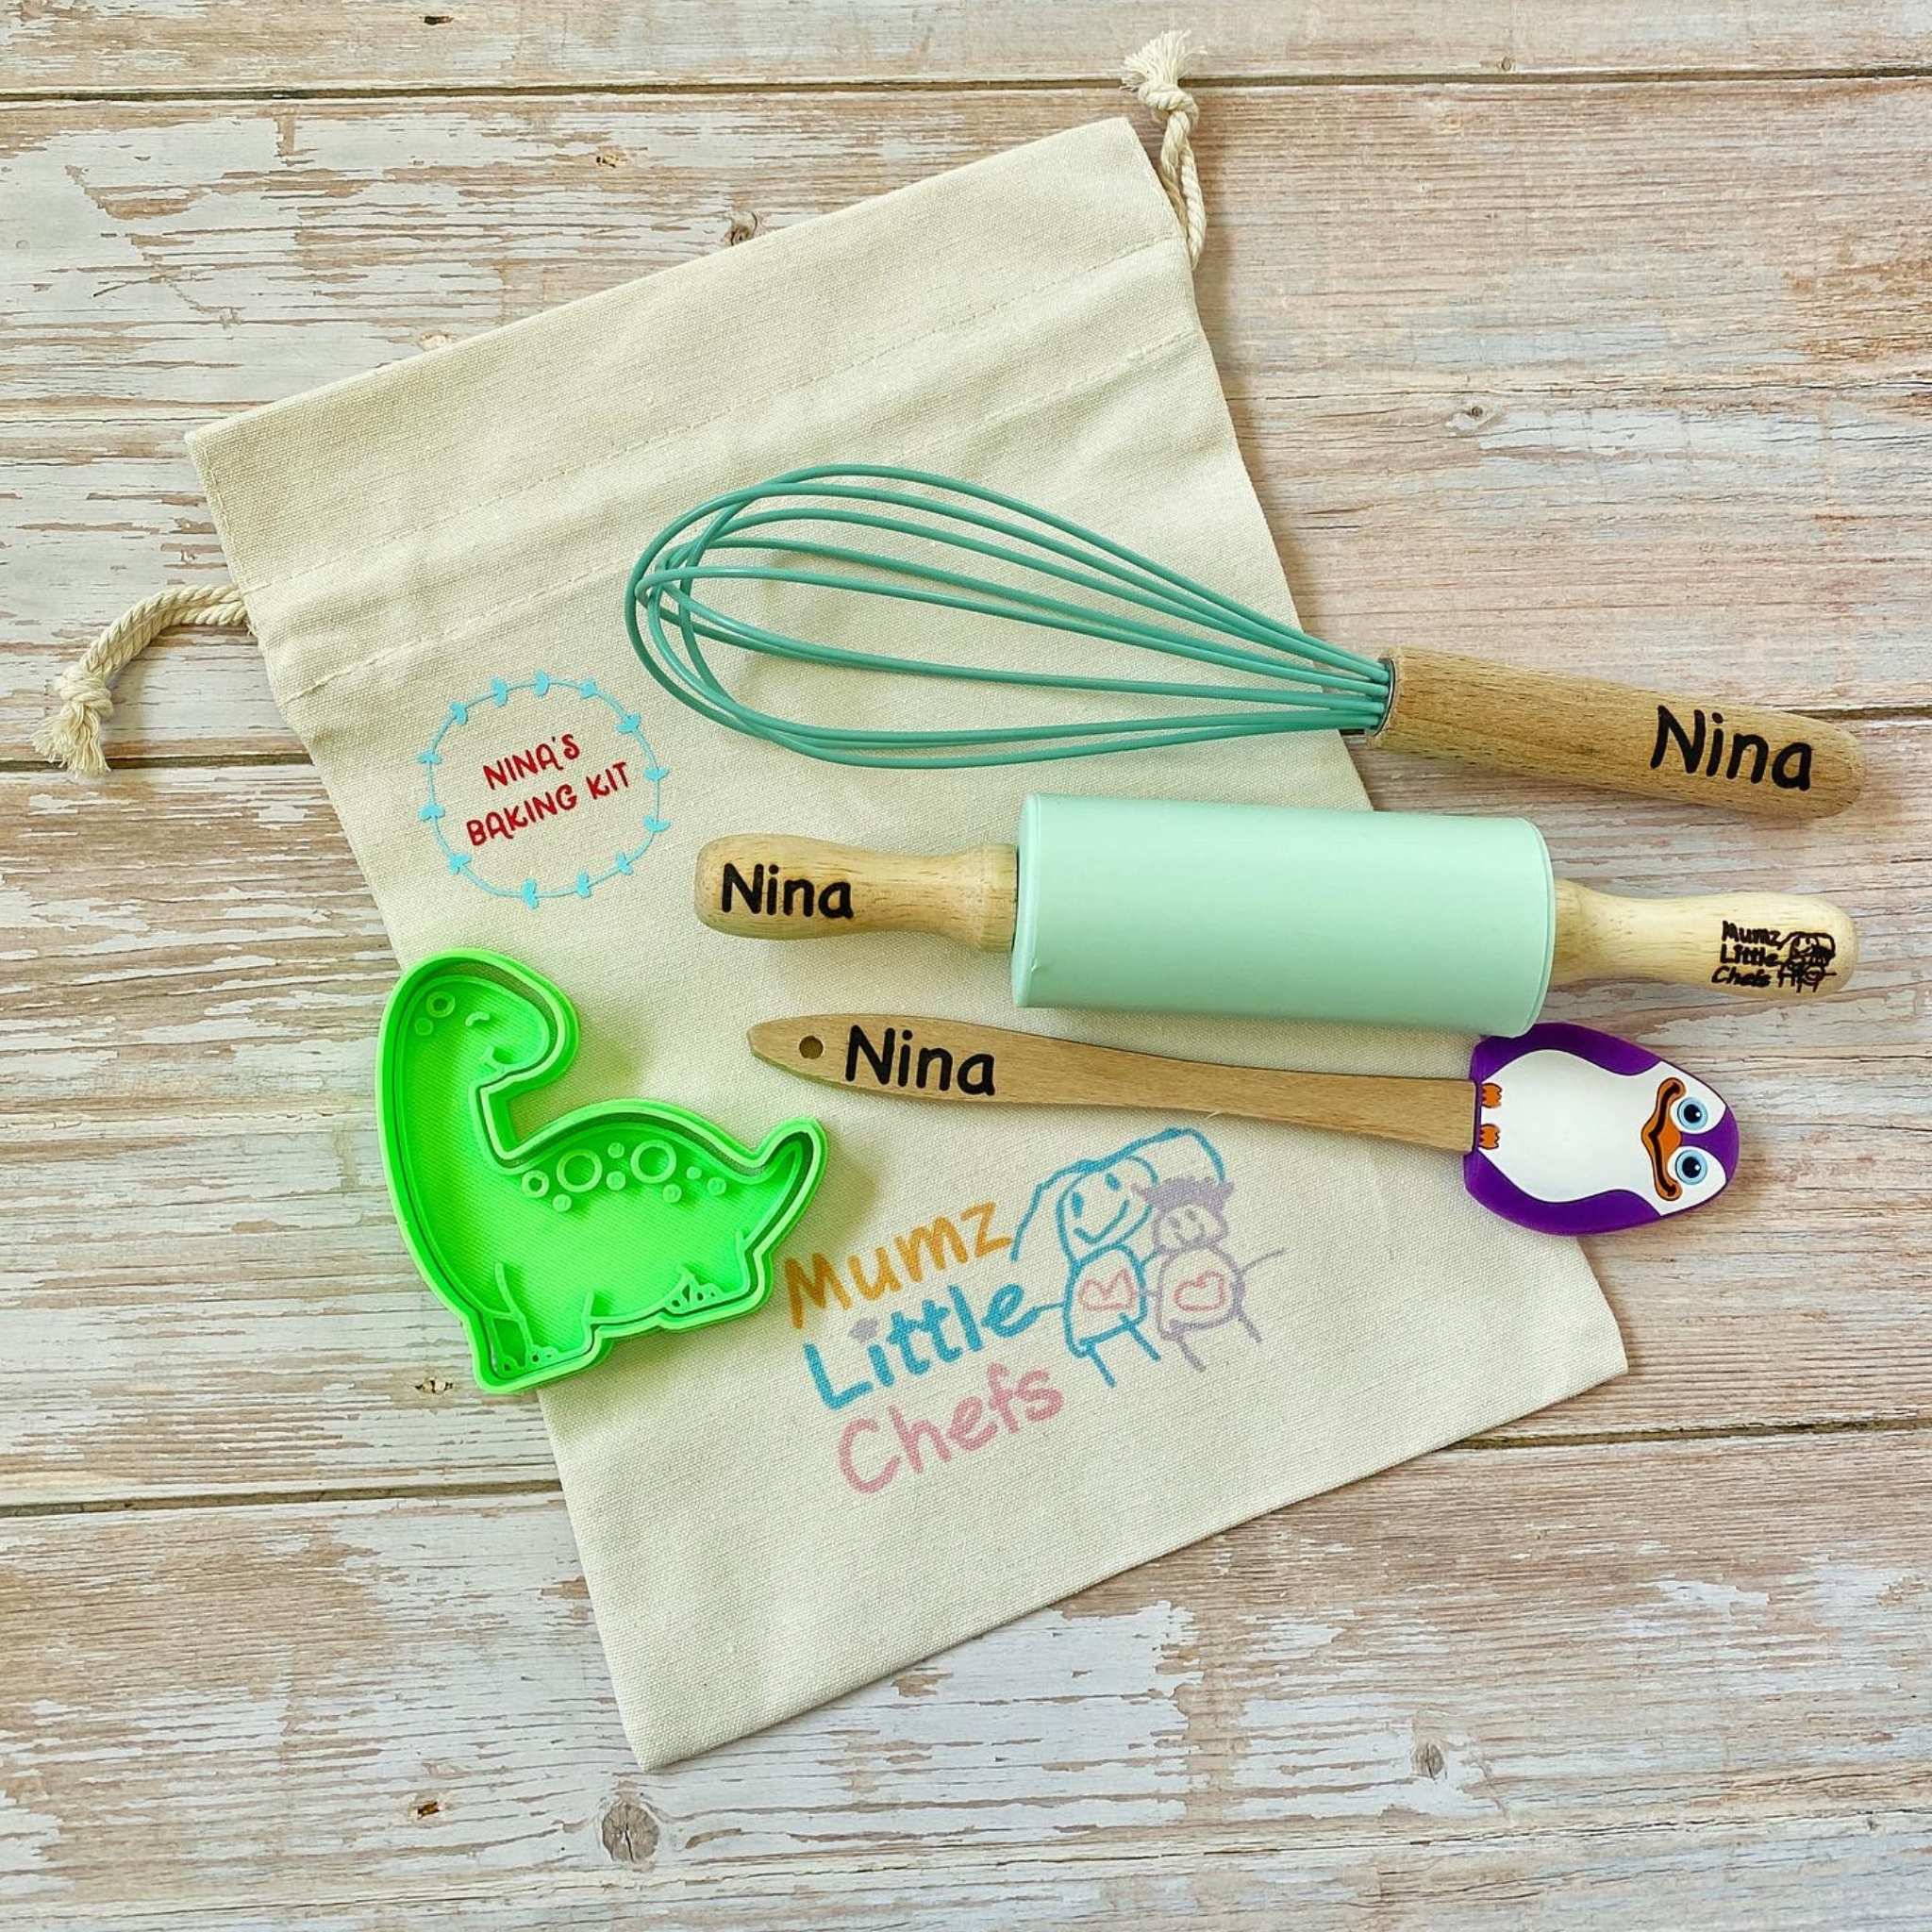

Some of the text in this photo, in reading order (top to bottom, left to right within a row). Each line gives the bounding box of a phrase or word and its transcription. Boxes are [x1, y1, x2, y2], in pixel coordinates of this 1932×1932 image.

[483, 734, 580, 790] NINA'S
[1650, 705, 1812, 791] Nina
[466, 761, 629, 846] BAKING KIT
[722, 863, 854, 919] Nina
[1722, 921, 1781, 947] Mumz
[845, 1024, 995, 1096] Nina
[783, 1201, 1012, 1329] Mumz
[804, 1283, 1038, 1409] Little
[839, 1362, 1063, 1493] Chefs
